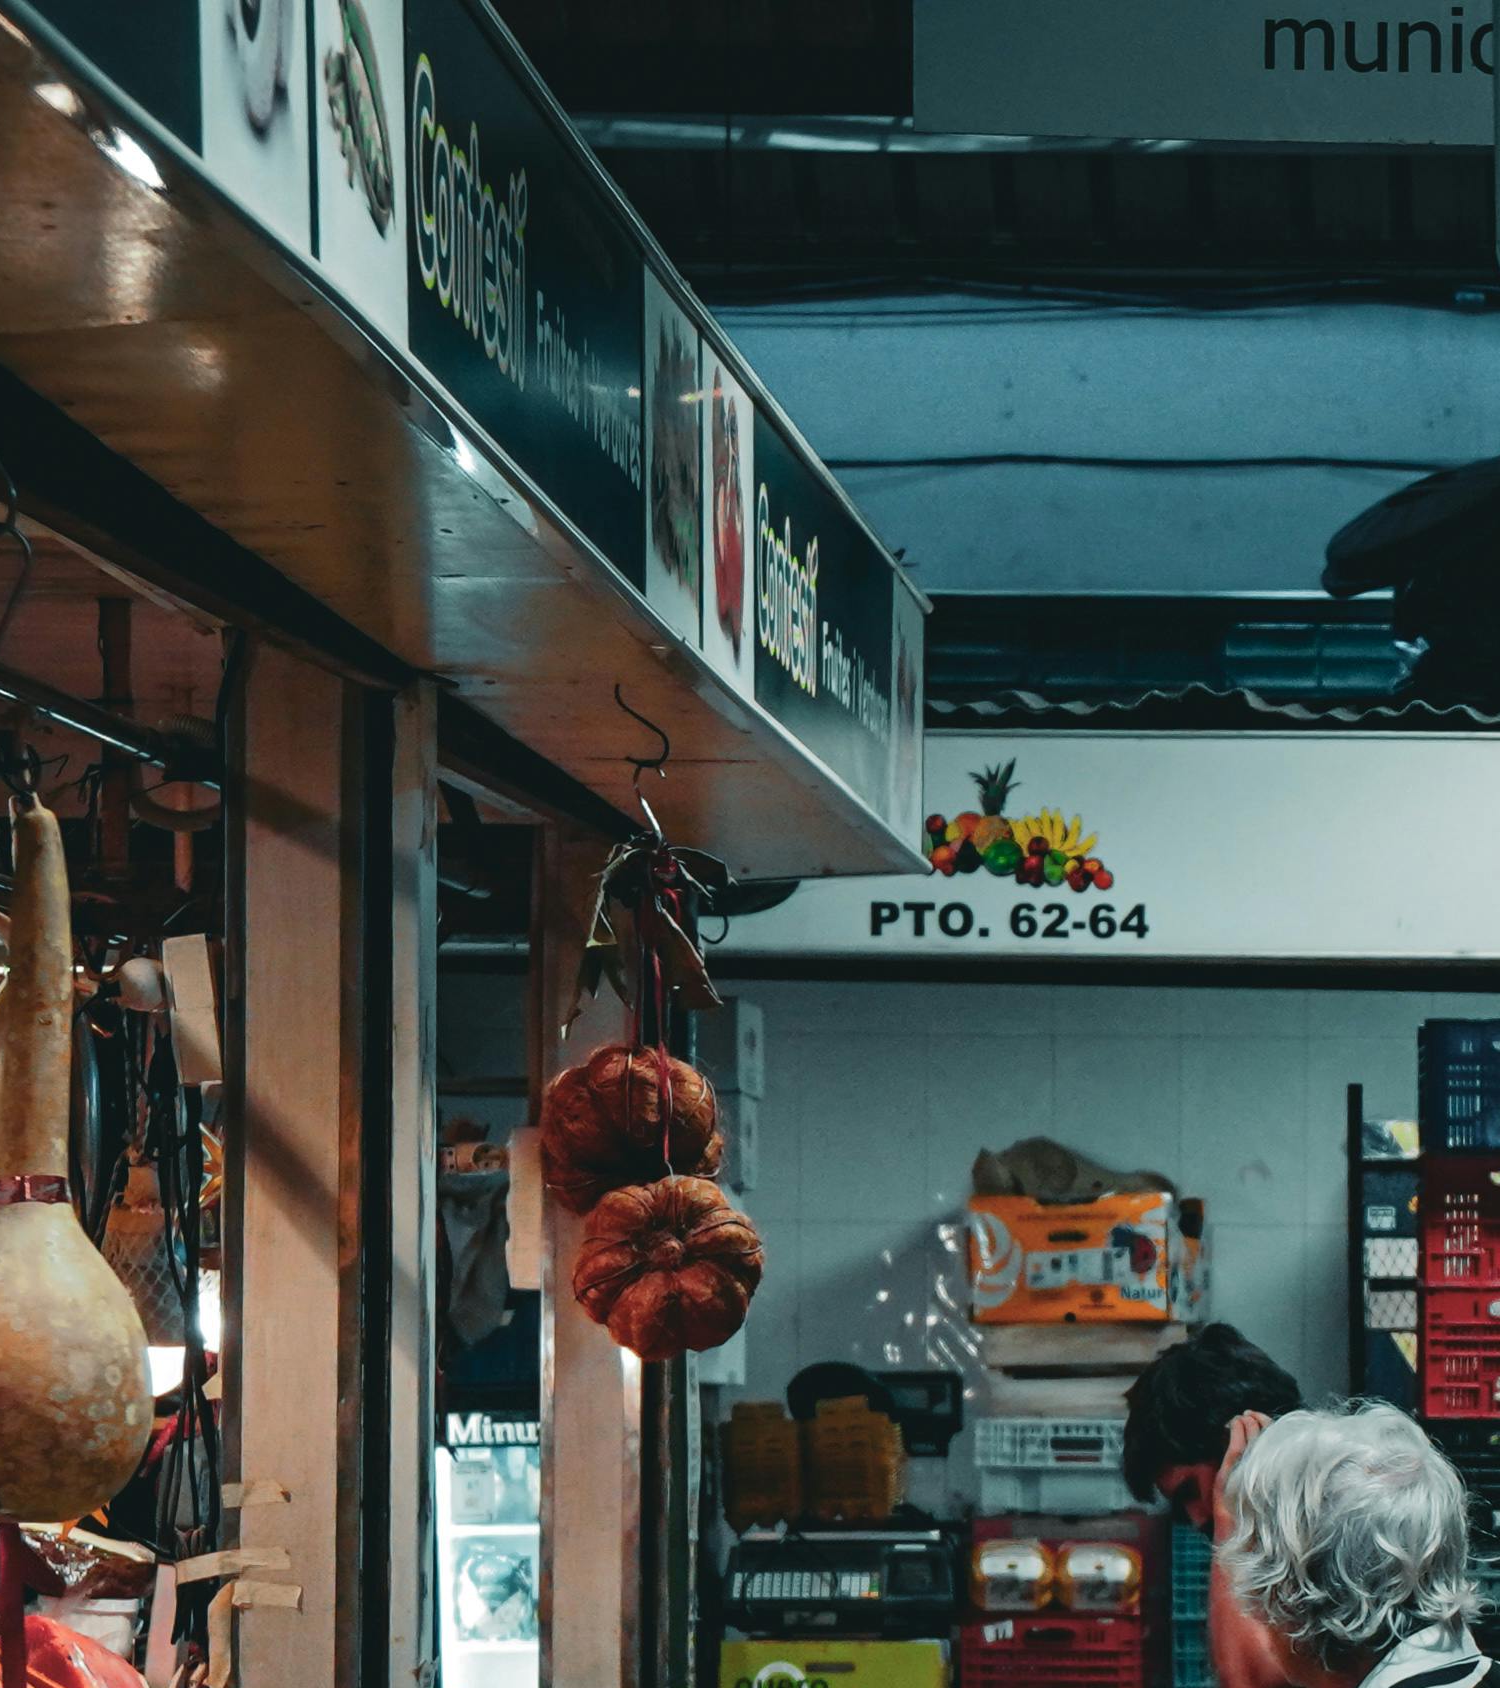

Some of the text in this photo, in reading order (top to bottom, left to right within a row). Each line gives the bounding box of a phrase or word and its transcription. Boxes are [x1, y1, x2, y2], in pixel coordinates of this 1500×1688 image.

[536, 289, 579, 422] Fruites
[822, 621, 851, 710] Fruites
[870, 902, 1149, 938] PTO. 62-64
